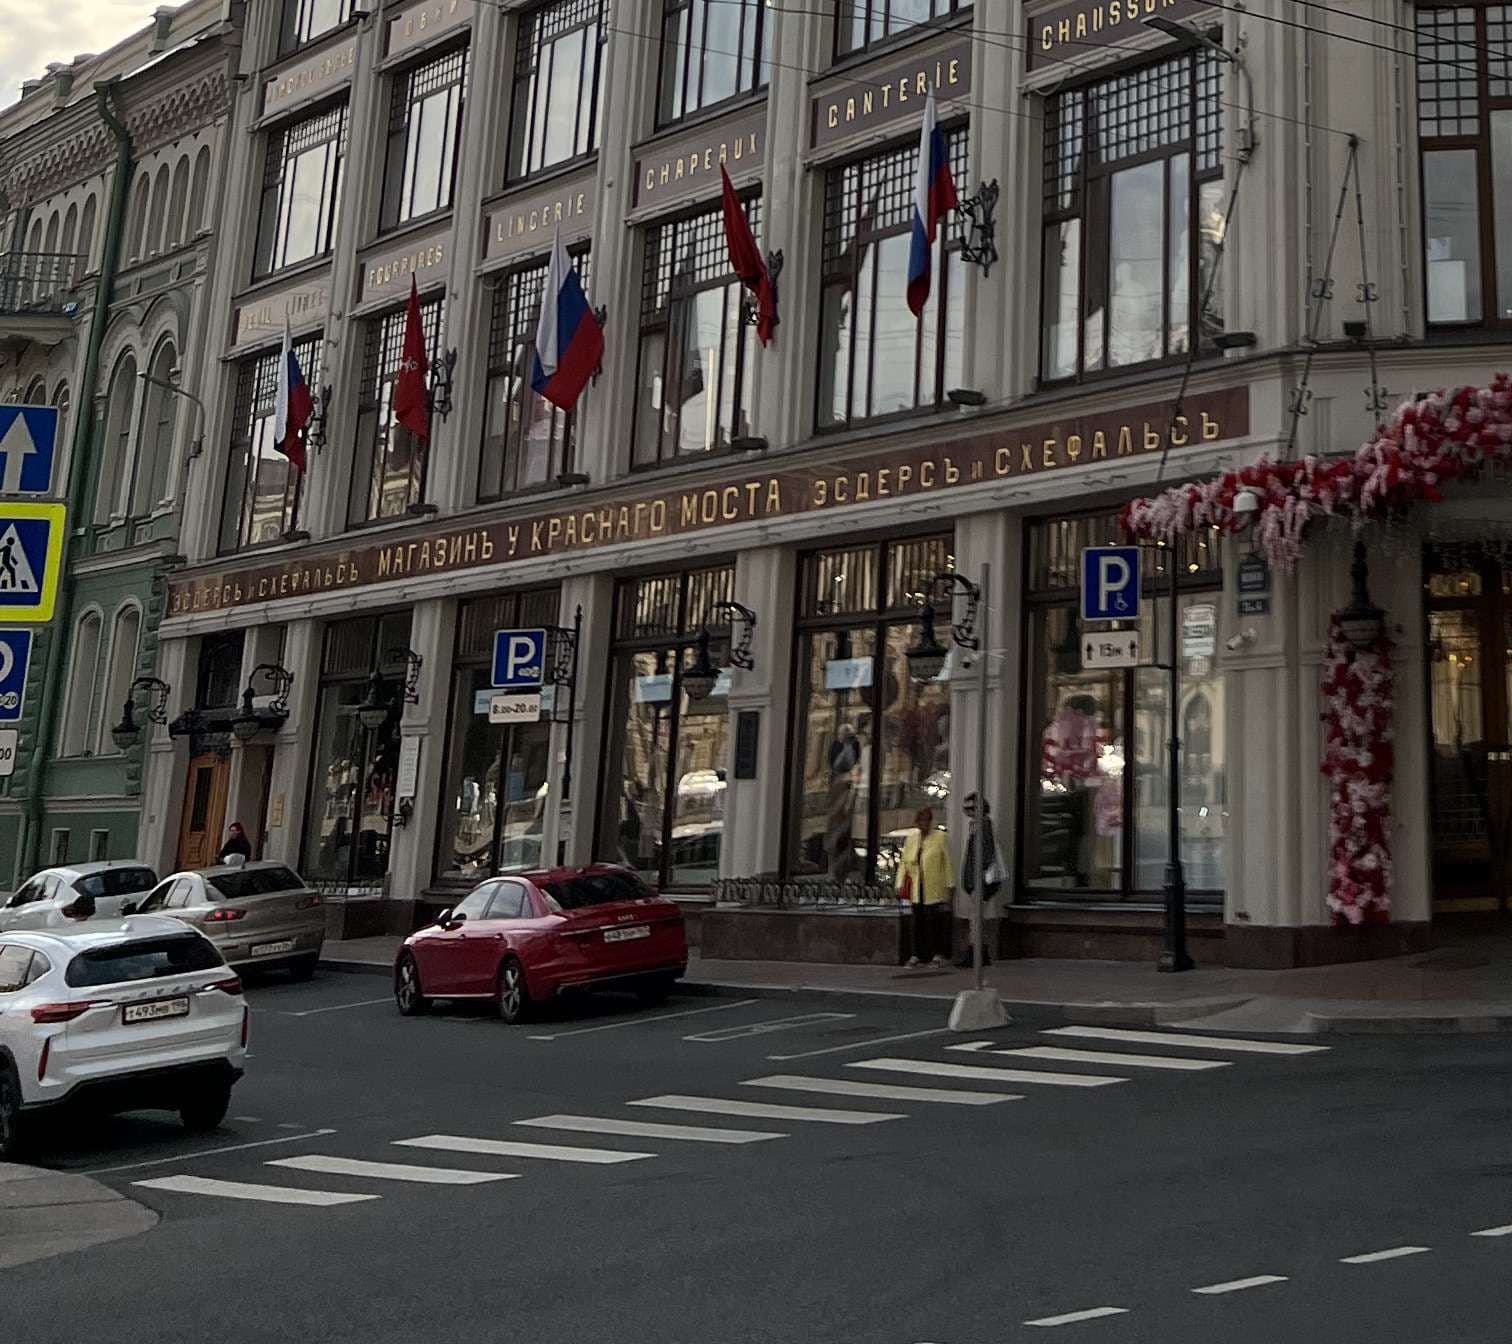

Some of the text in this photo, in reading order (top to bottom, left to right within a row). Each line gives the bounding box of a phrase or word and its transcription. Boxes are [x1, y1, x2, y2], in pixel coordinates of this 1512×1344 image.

[644, 132, 758, 190] CHAPEAUX
[377, 530, 494, 578] МАГАЗИНЪ
[507, 525, 519, 556] У
[529, 499, 667, 553] КРАСНАГО
[680, 477, 782, 529] МОСТА
[812, 457, 961, 506] ЭСДЕРСЪ
[994, 411, 1221, 476] СХЕФАЛЬСЪ
